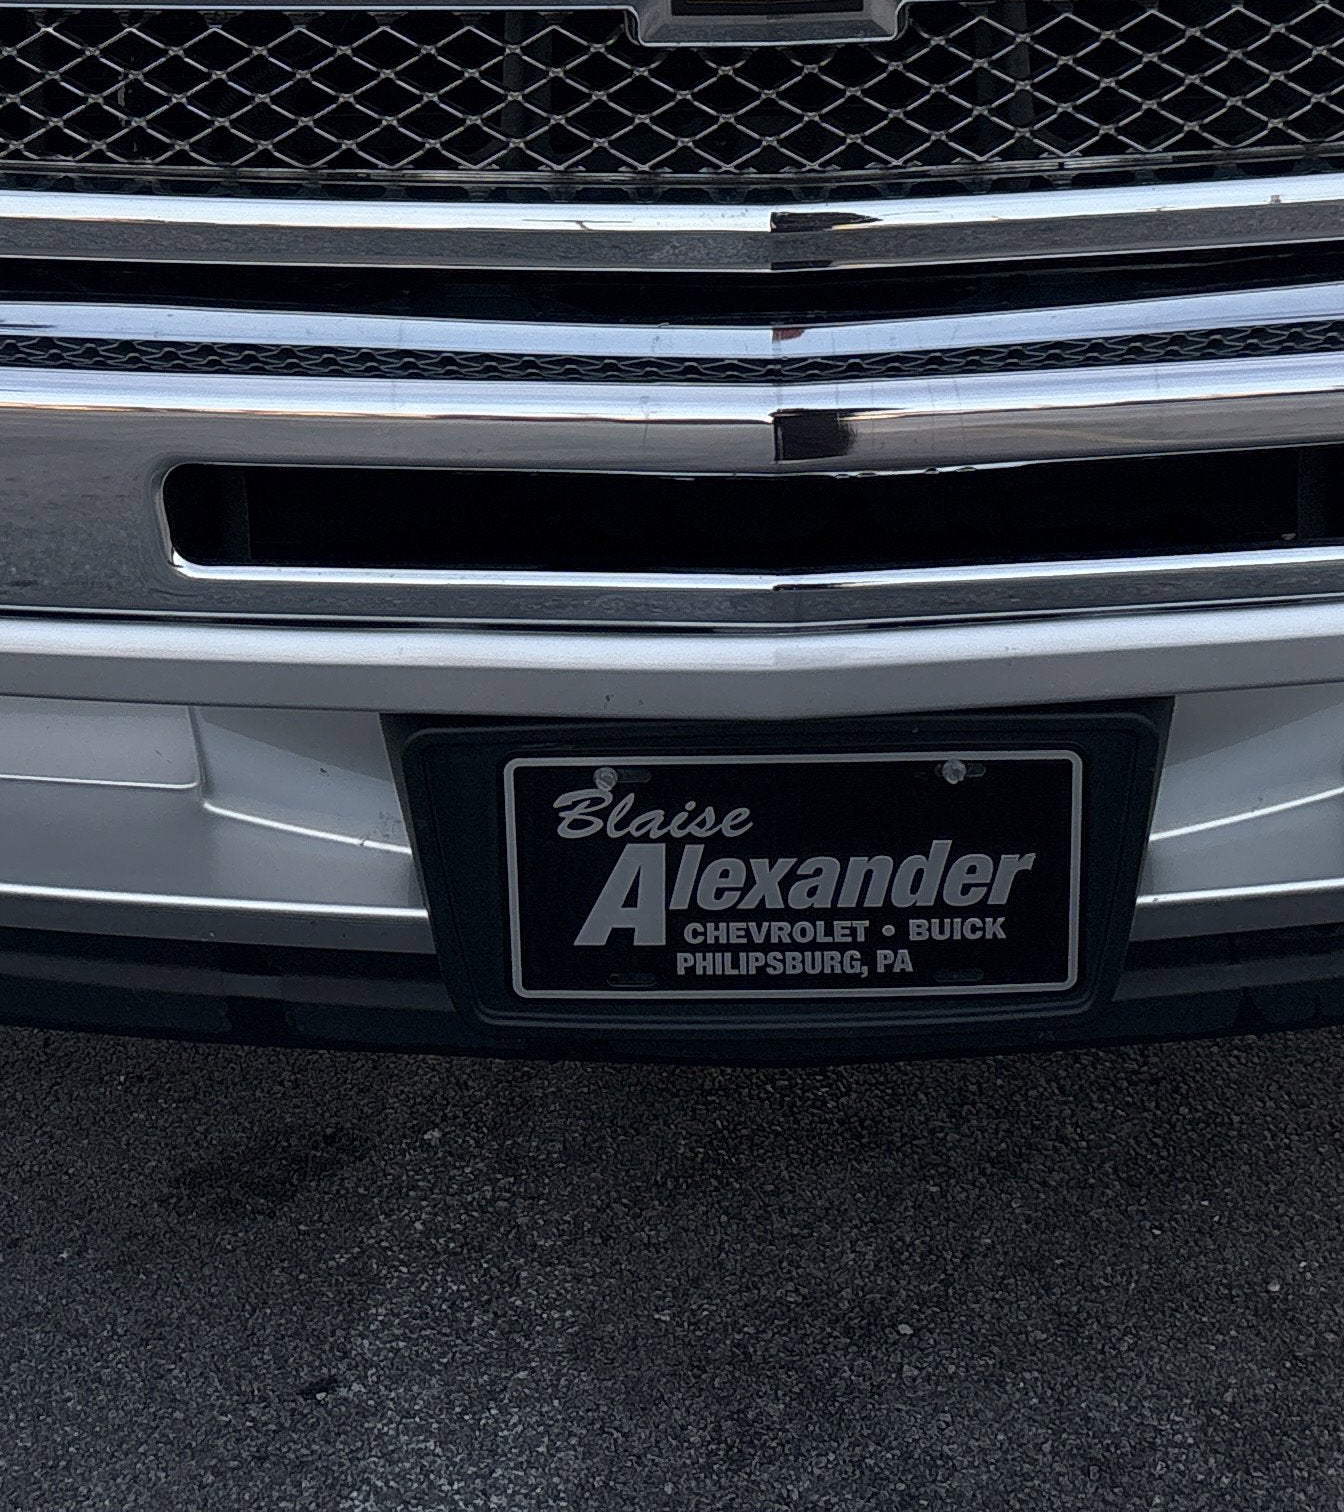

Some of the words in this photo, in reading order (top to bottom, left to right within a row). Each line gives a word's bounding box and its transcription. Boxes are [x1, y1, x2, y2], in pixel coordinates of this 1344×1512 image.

[553, 788, 754, 840] Blaise
[573, 839, 1036, 946] Alexander
[683, 920, 870, 945] CHEVROLET
[908, 916, 1007, 941] BUICK
[676, 950, 868, 978] PHILIPSBURG,
[876, 949, 914, 974] PA
